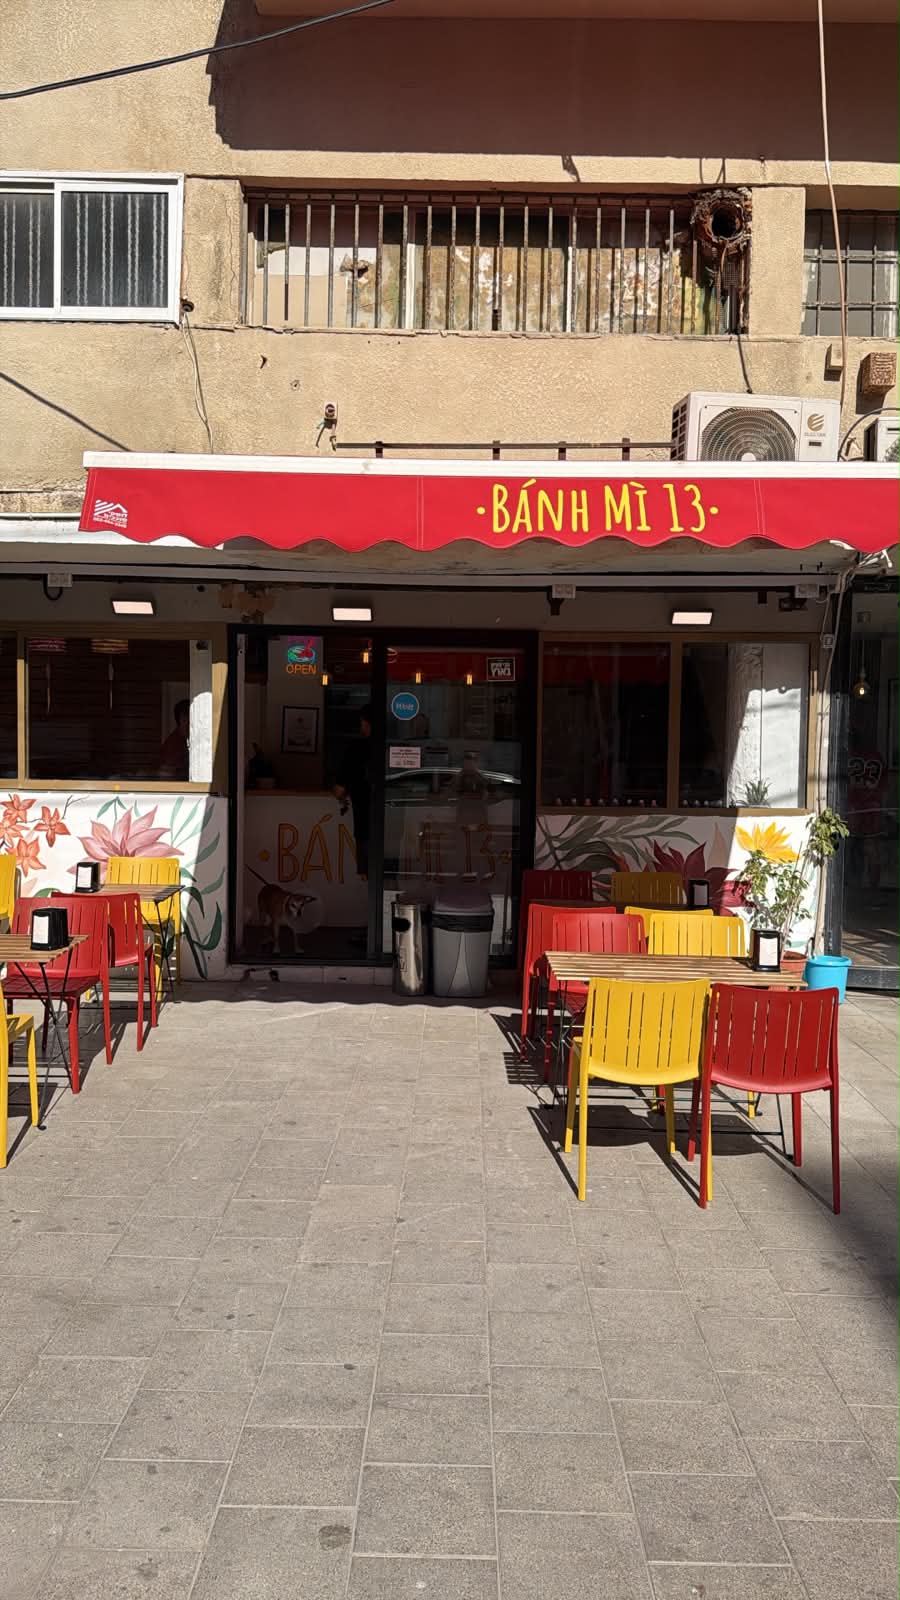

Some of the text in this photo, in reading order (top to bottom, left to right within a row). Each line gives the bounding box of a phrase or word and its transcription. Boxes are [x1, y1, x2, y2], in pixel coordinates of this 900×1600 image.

[492, 478, 706, 534] BÁNH MÌ 13
[286, 663, 317, 674] OPEN
[277, 813, 368, 884] BÁN
